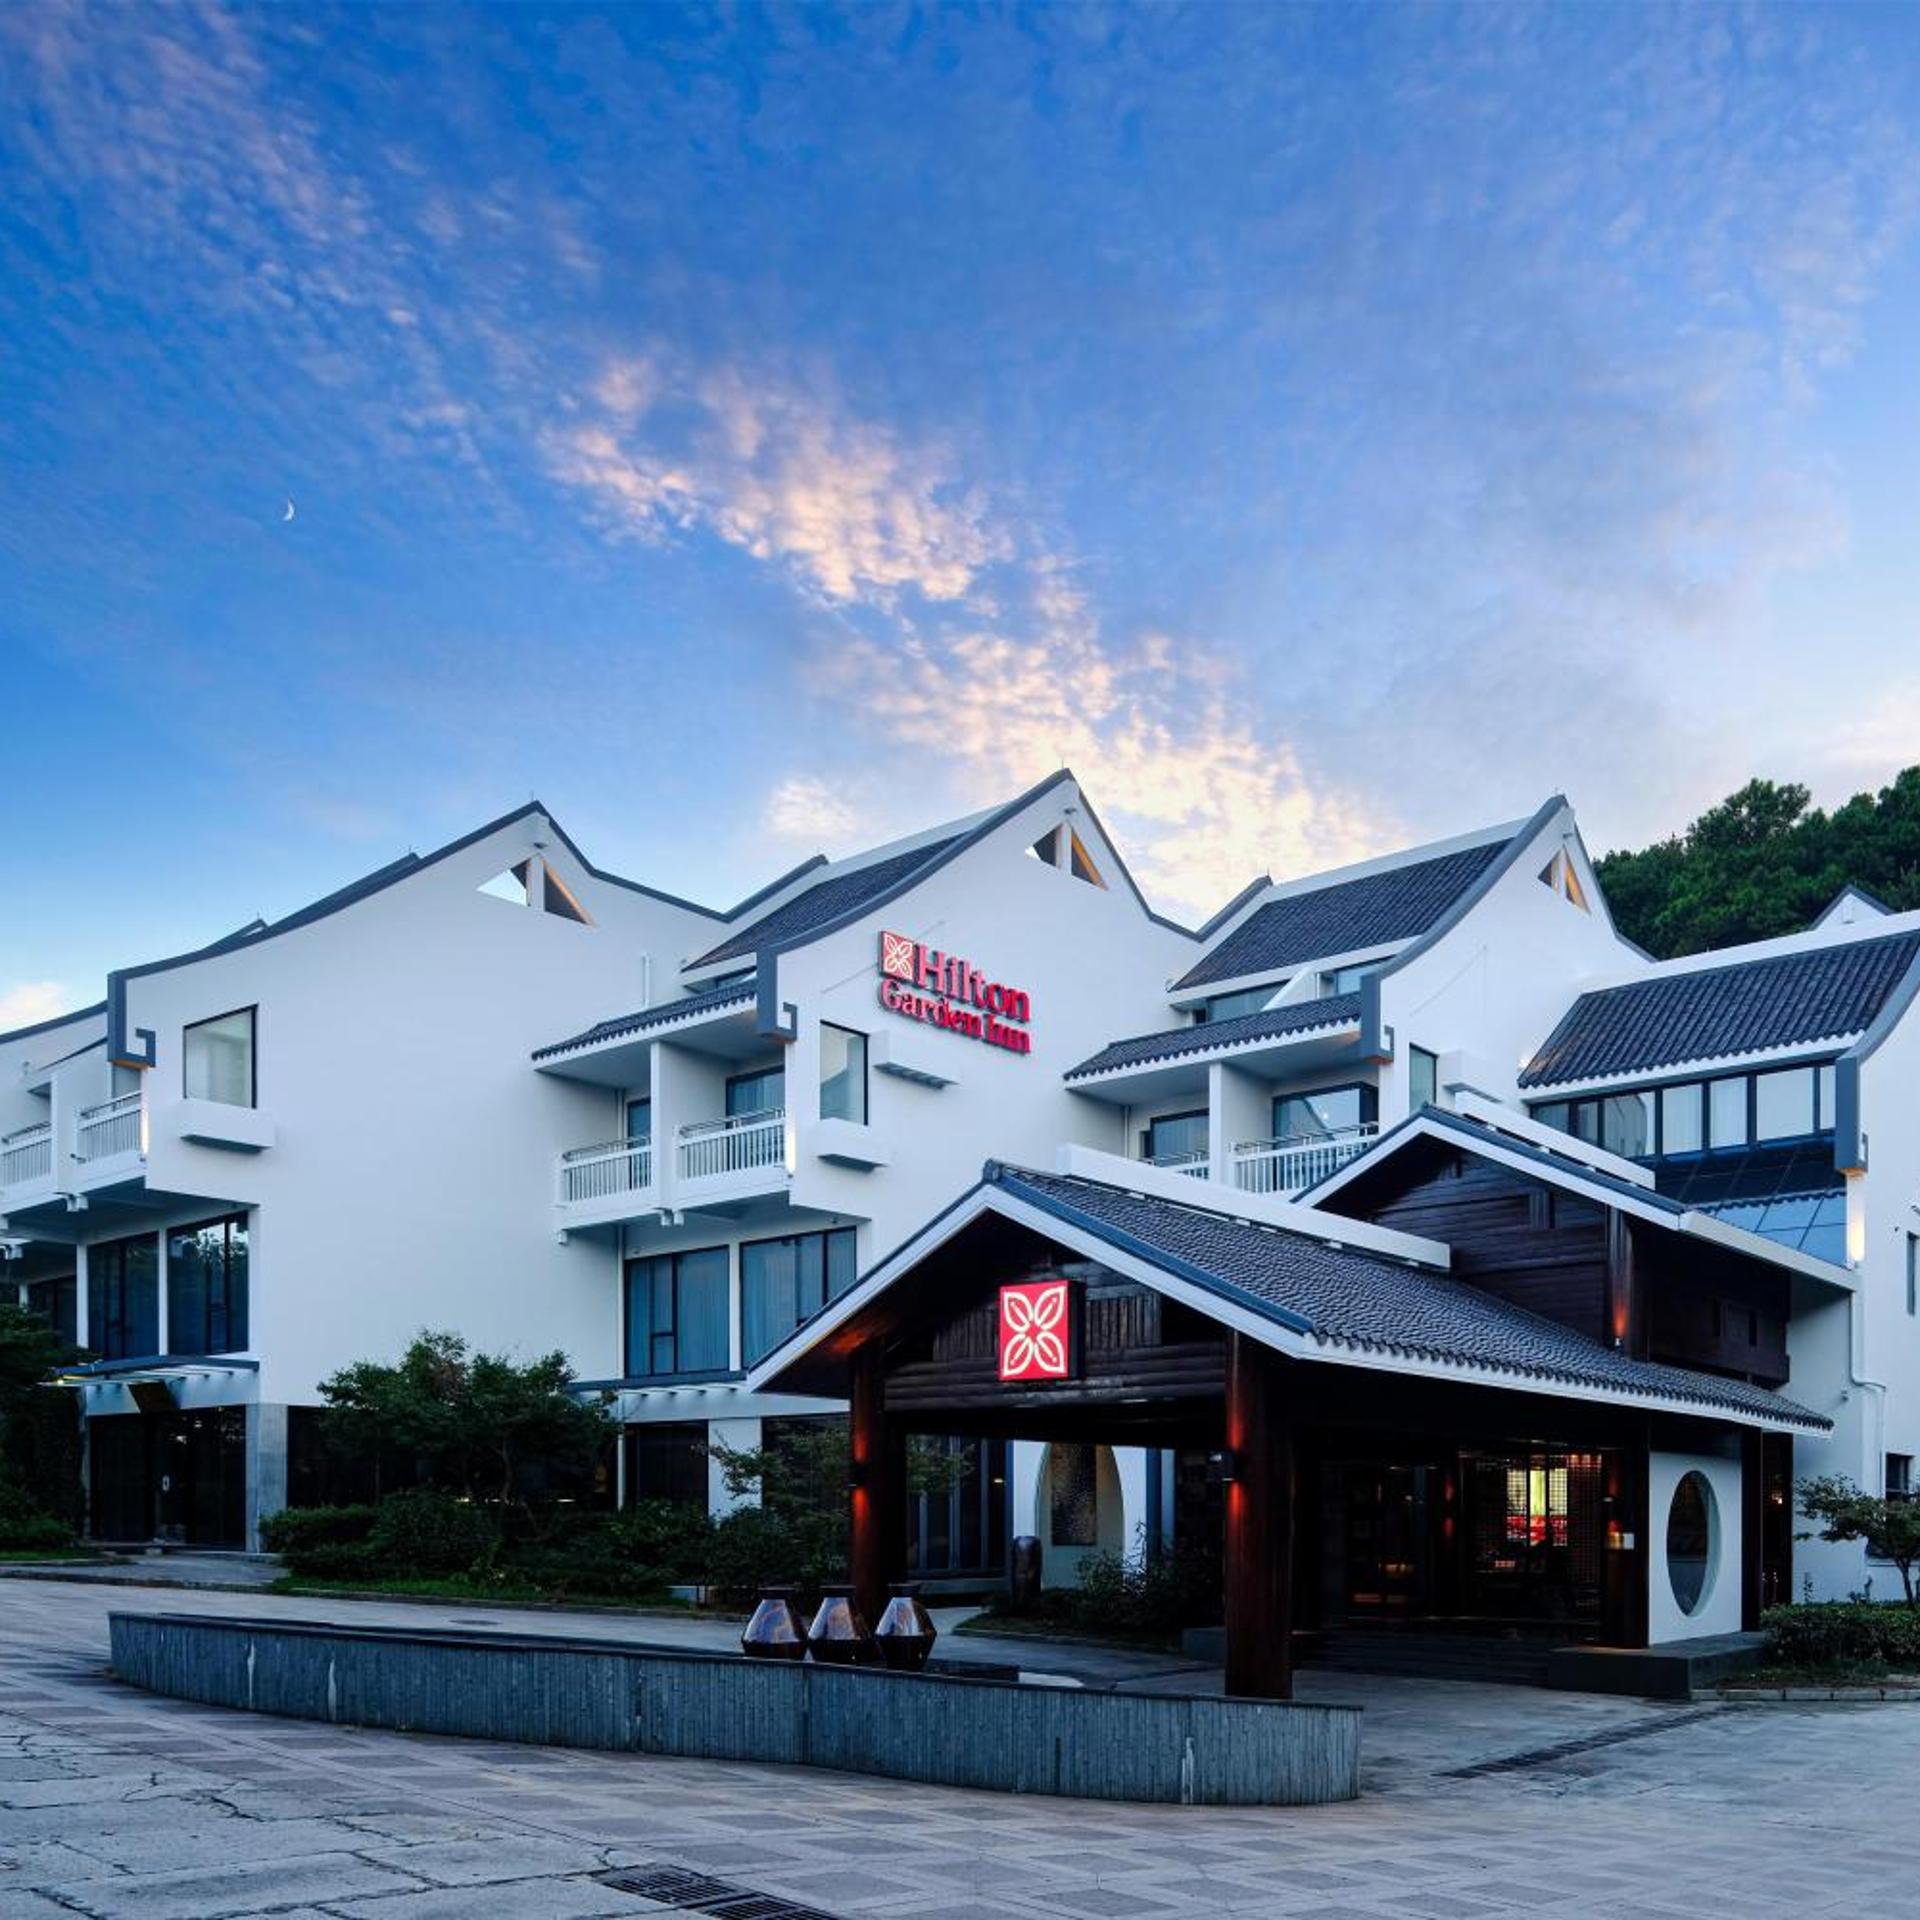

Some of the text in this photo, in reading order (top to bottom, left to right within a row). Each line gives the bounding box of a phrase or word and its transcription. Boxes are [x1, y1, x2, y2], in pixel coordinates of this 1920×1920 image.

[880, 978, 1031, 1054] Garden Inn
[915, 943, 1030, 1023] Hilton
